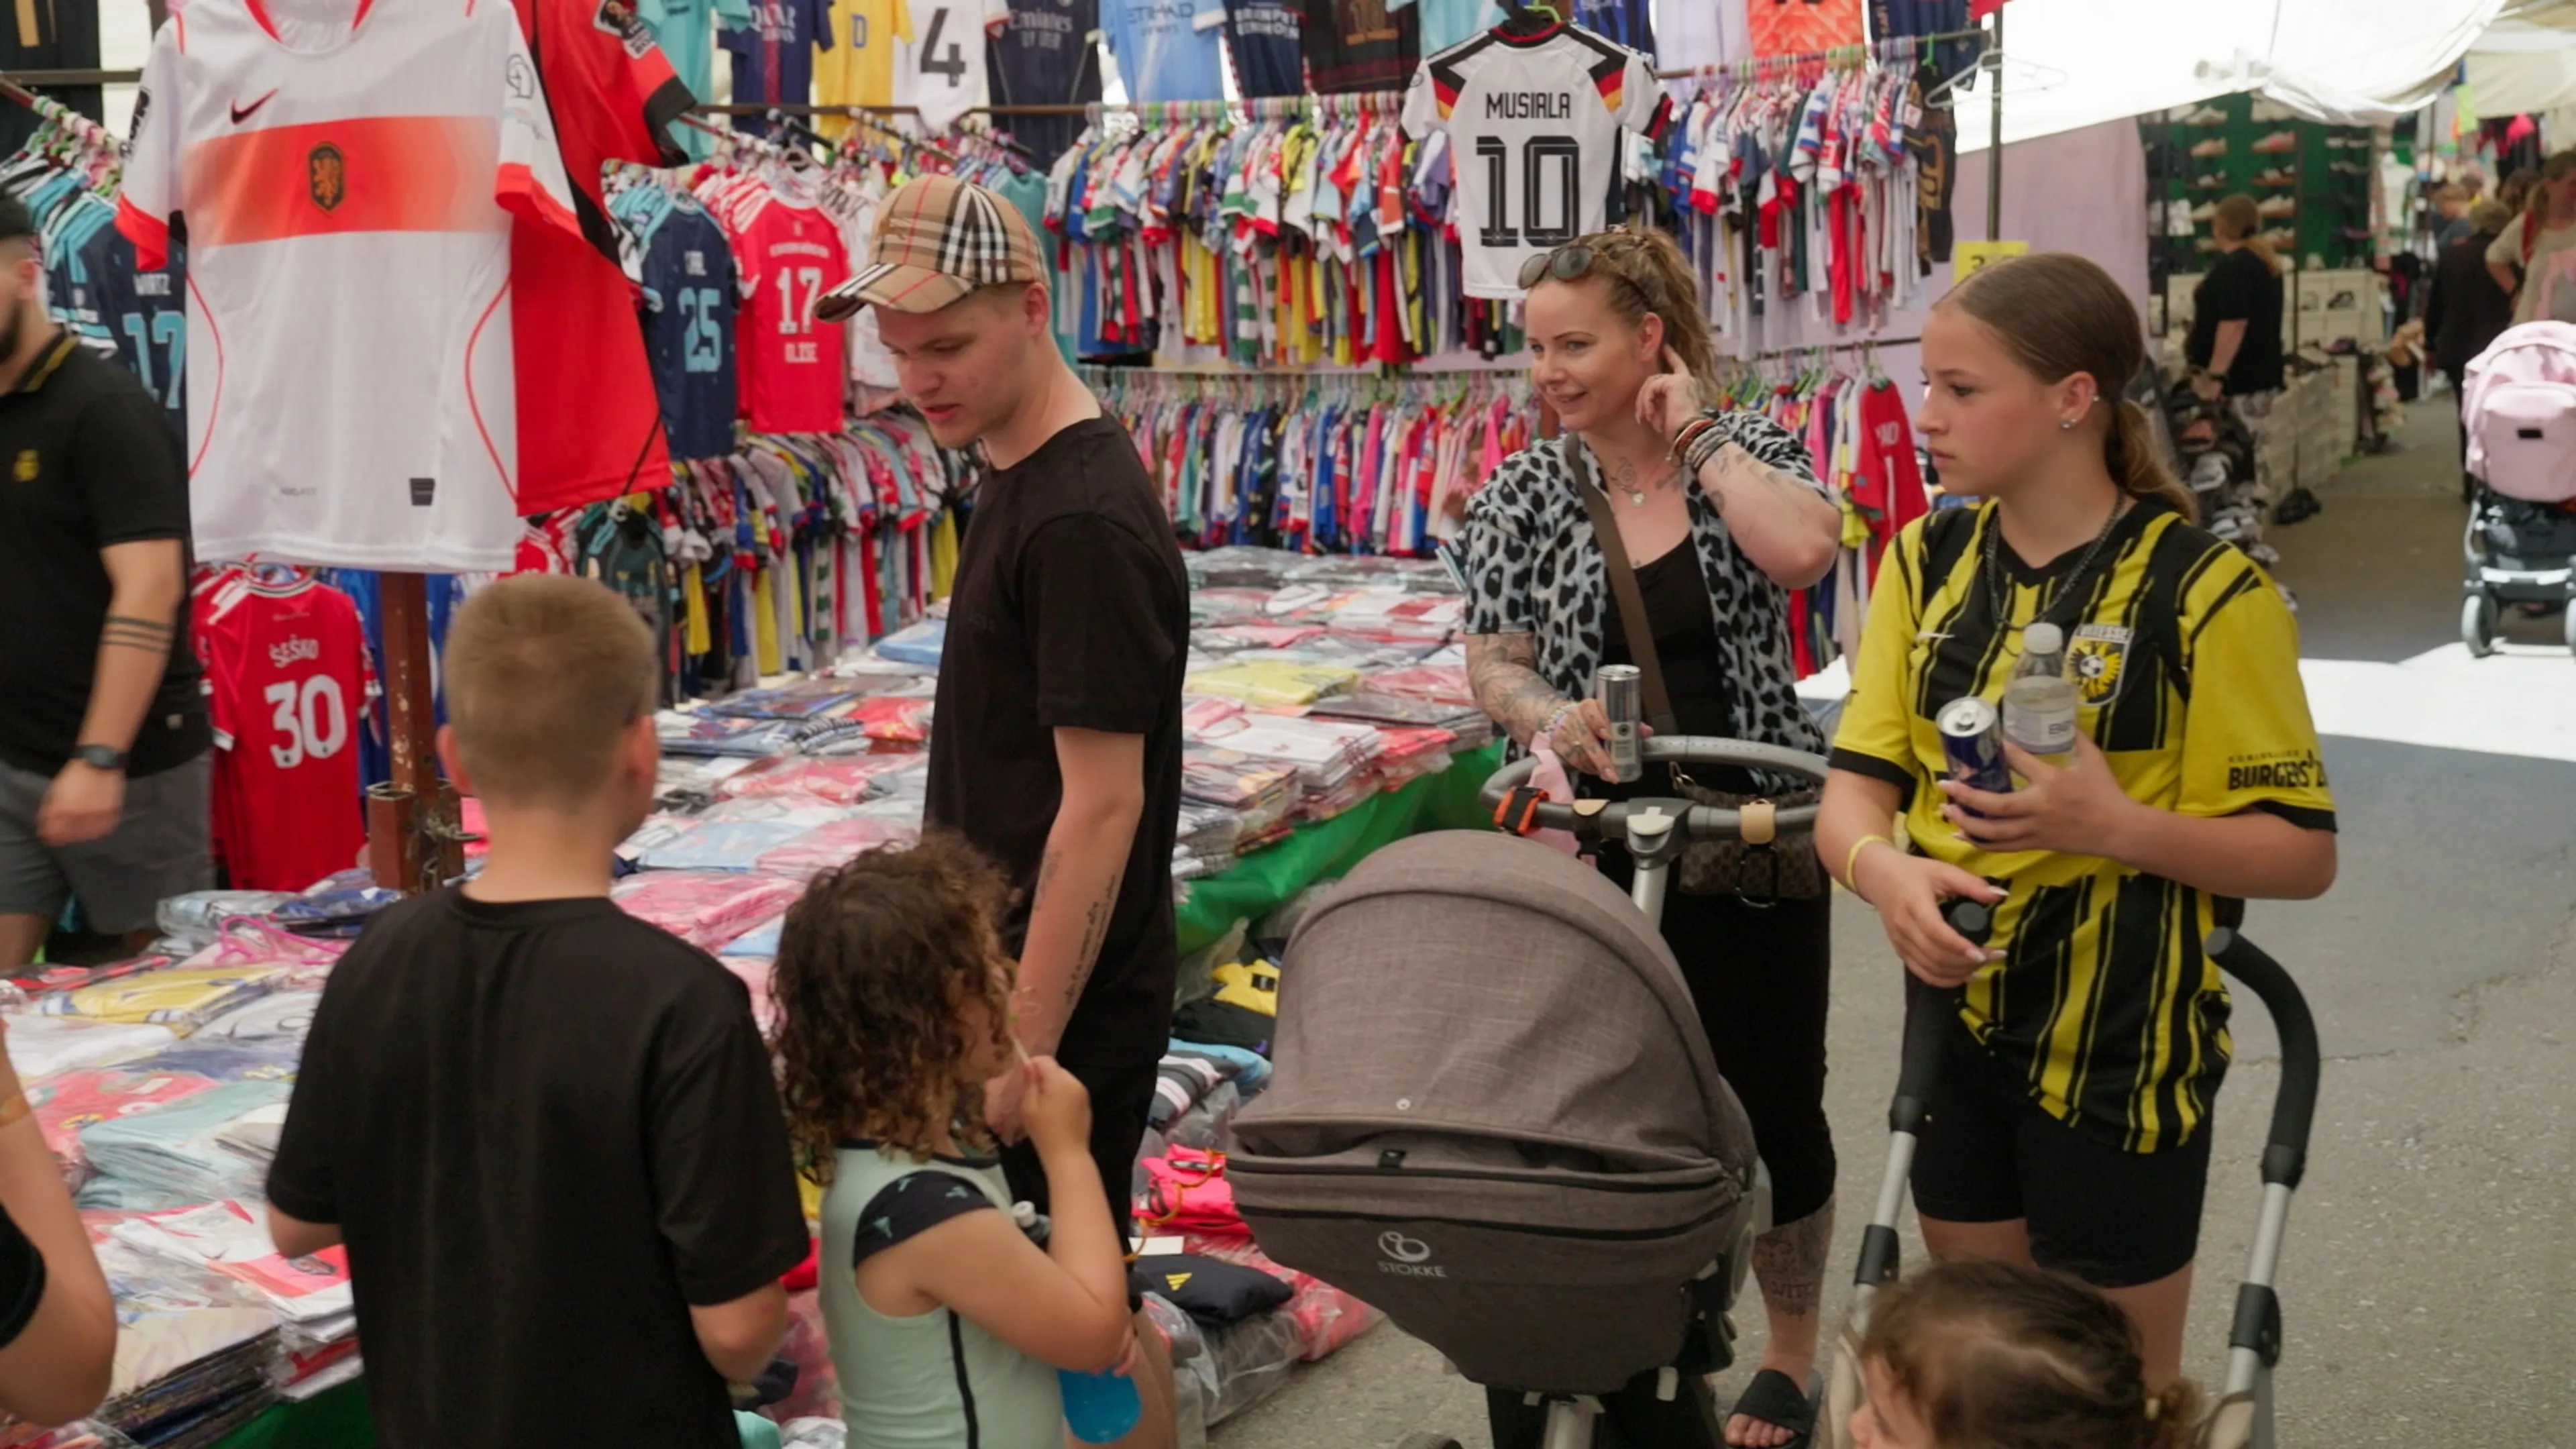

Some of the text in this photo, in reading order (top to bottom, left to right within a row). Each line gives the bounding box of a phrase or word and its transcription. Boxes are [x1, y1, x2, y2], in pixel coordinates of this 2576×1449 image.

[920, 8, 966, 87] 4
[1127, 2, 1195, 24] ETIHAD
[1485, 92, 1571, 119] MUSIALA
[1476, 136, 1580, 247] 10
[677, 286, 722, 372] 25
[776, 266, 822, 334] 17
[121, 310, 187, 409] 17
[264, 673, 348, 769] 30
[1377, 1260, 1448, 1278] STOKKE
